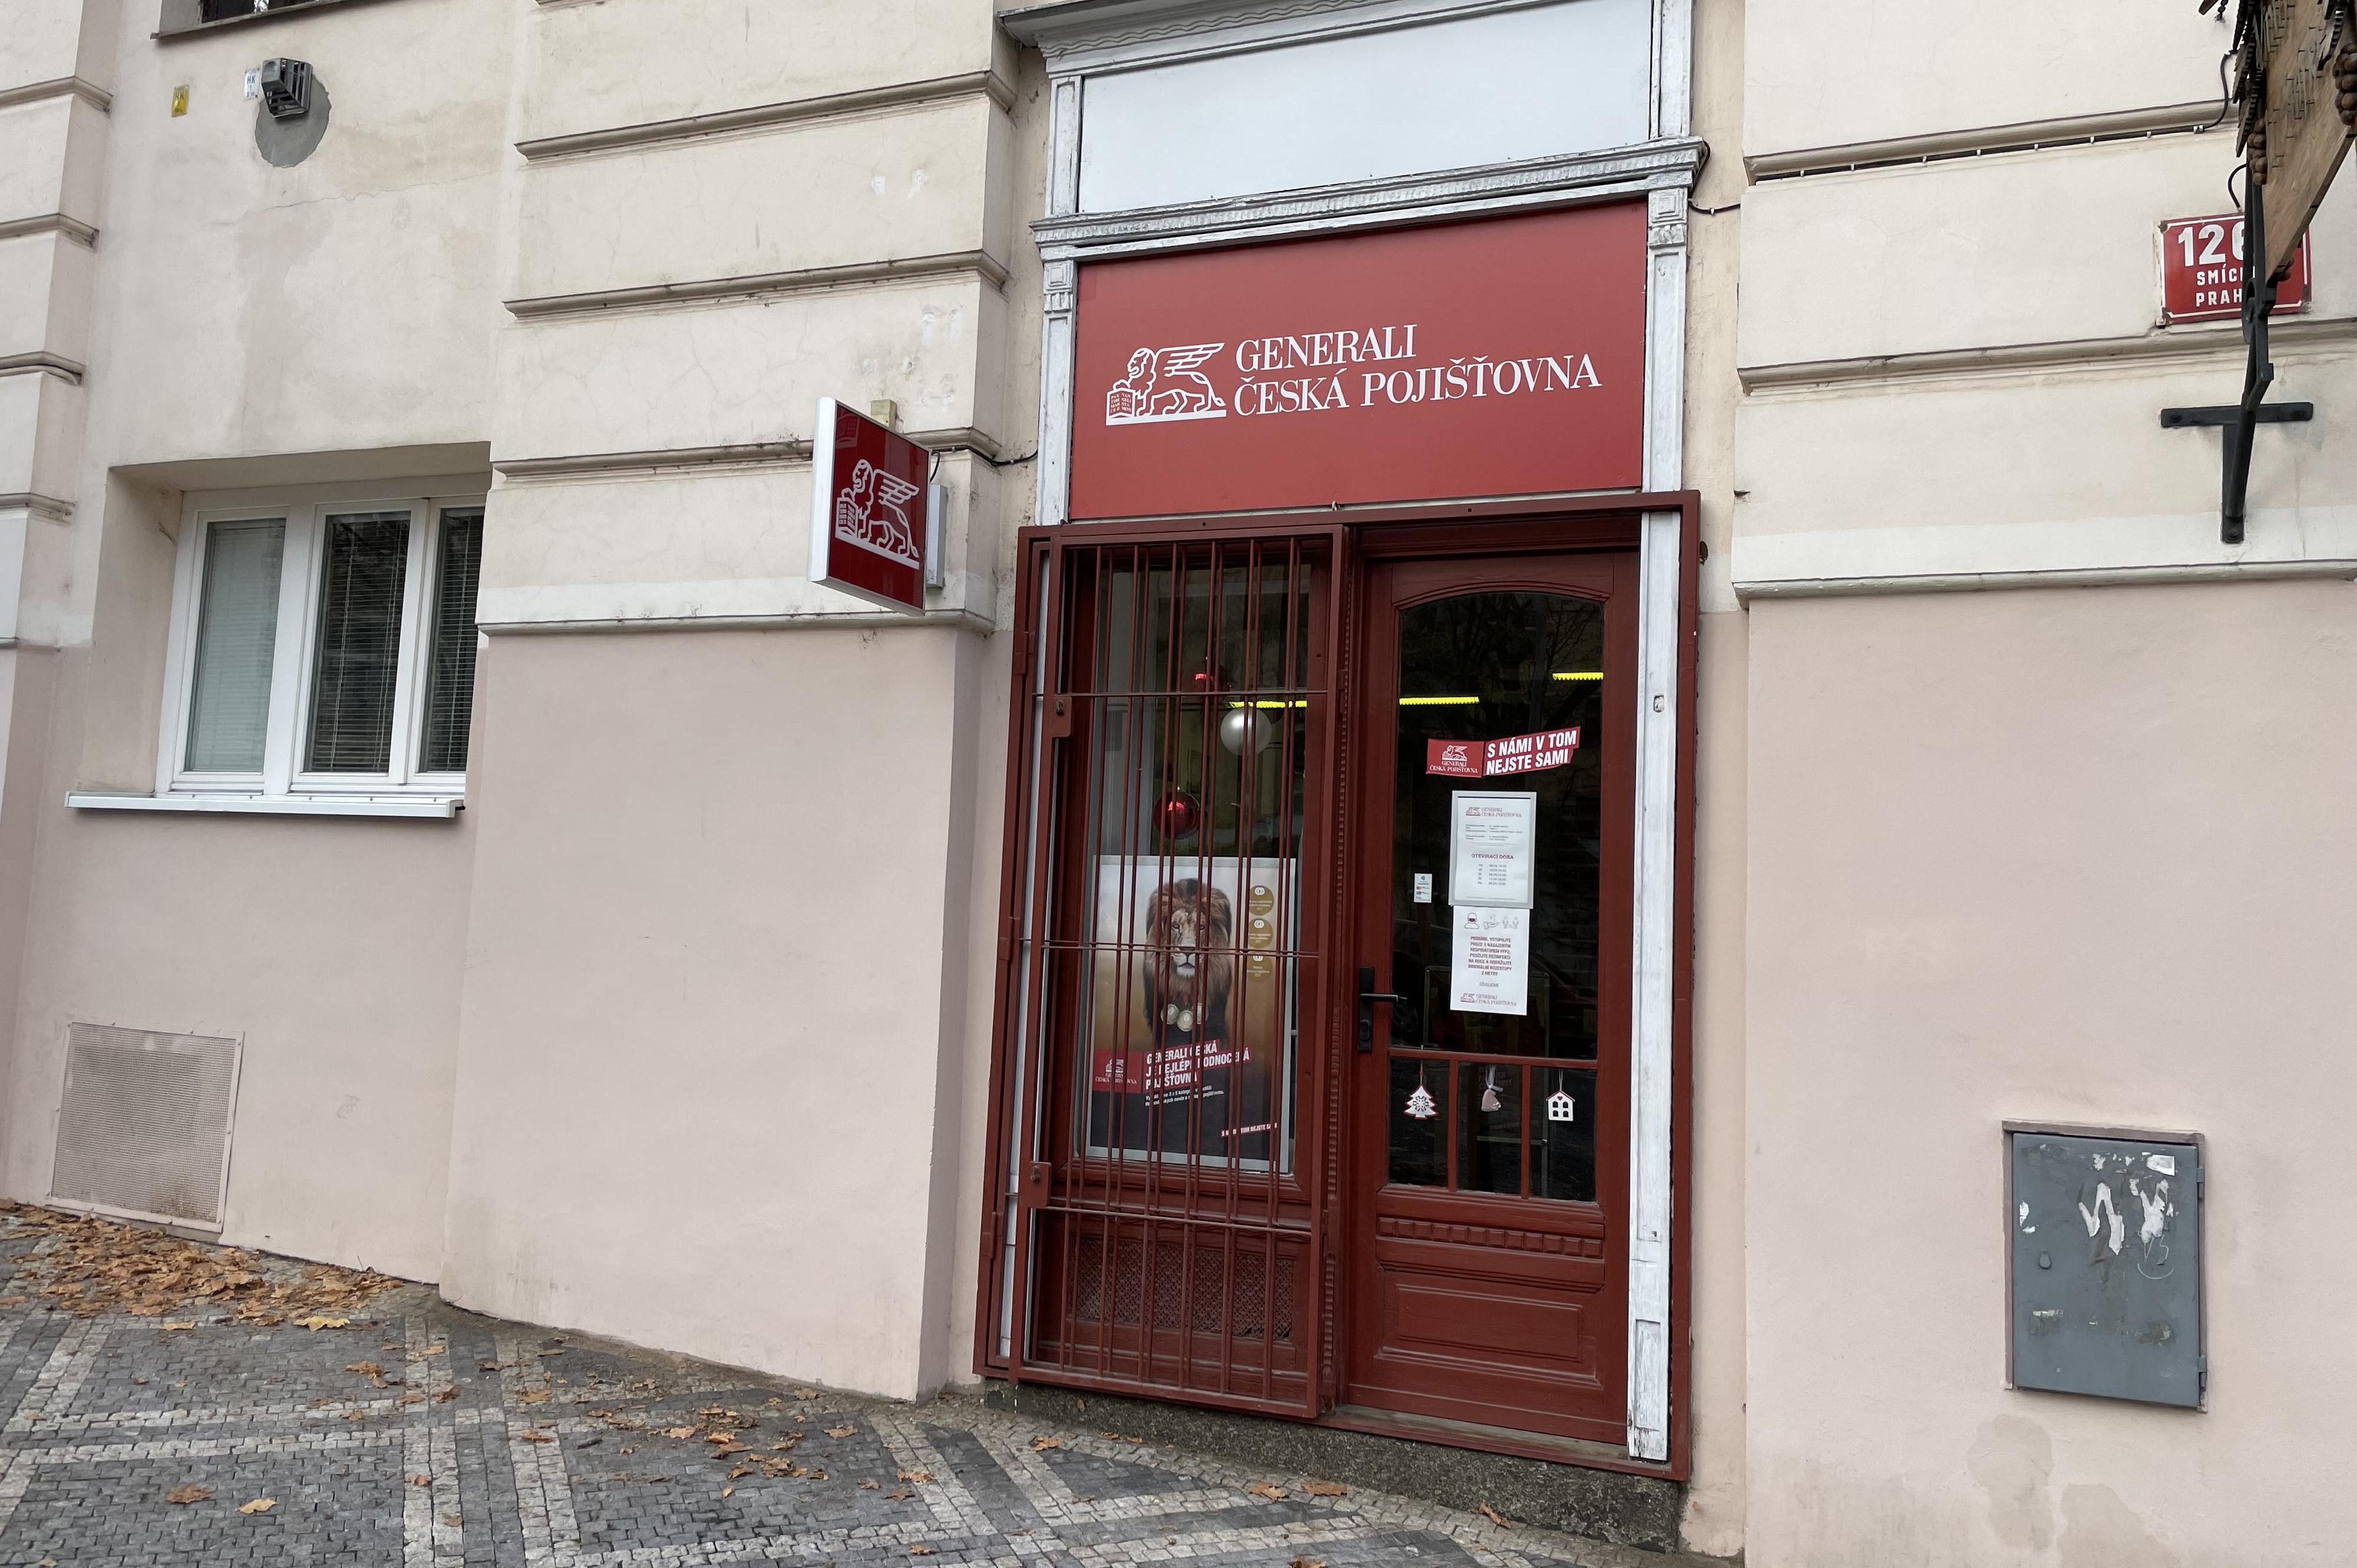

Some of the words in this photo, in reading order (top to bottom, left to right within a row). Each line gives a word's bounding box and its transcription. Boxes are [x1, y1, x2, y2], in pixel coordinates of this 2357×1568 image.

[2196, 288, 2243, 307] PRAH
[1236, 324, 1417, 373] GENERALI
[1234, 368, 1349, 417] ČESKÁ
[1364, 354, 1602, 407] POJIŠŤOVNA
[1487, 743, 1496, 758] S
[1498, 737, 1531, 757] NÁMI
[1536, 735, 1545, 750] V
[1548, 730, 1577, 748] TOM
[1486, 754, 1532, 775] NEJSTE
[1535, 748, 1569, 767] SAMI
